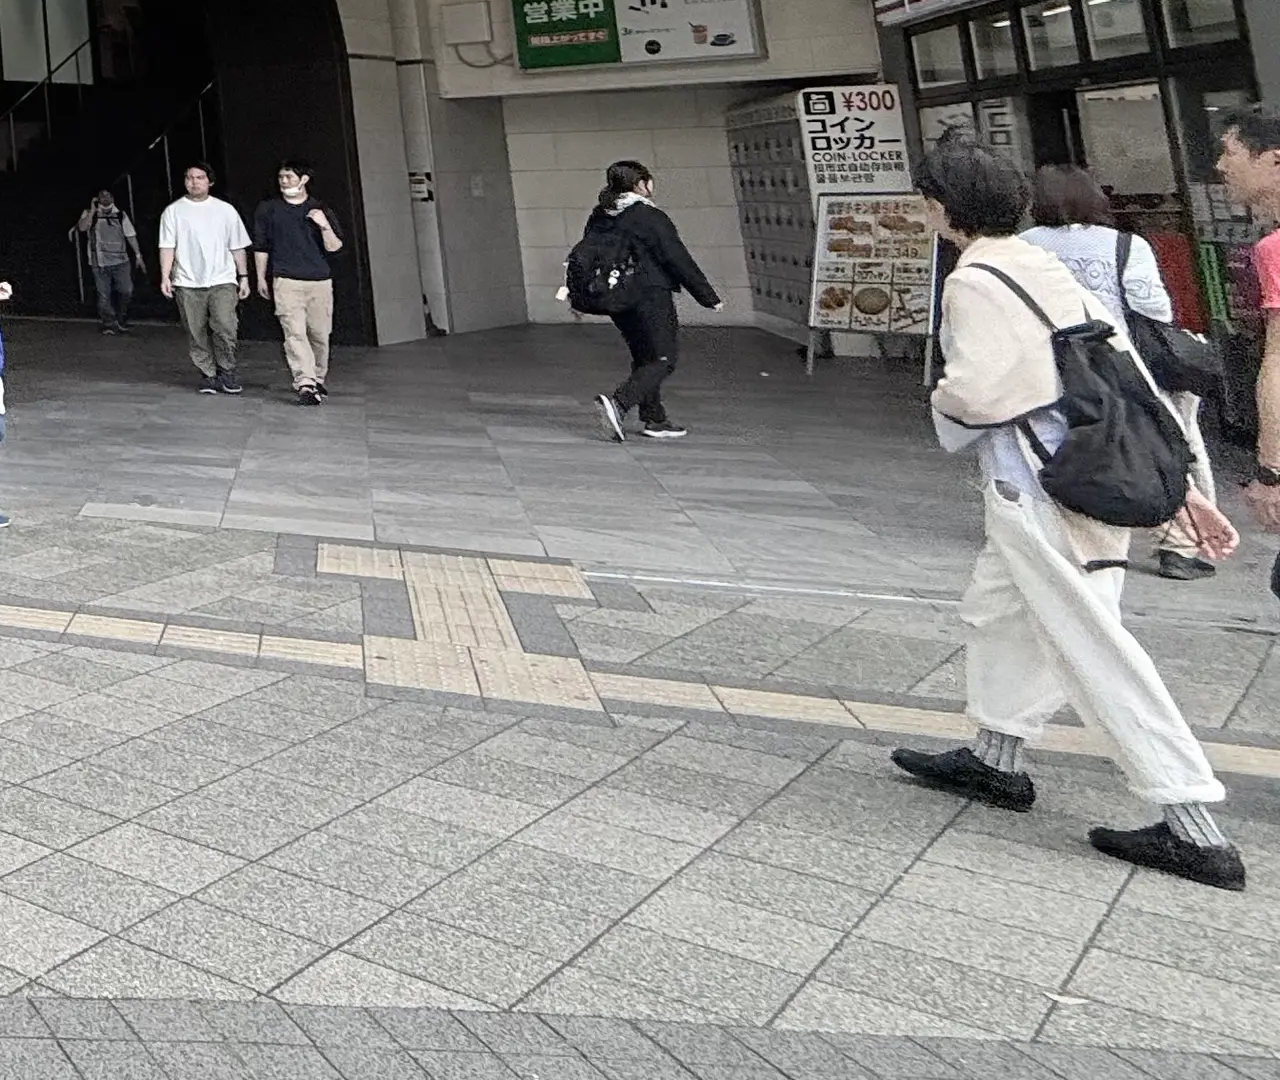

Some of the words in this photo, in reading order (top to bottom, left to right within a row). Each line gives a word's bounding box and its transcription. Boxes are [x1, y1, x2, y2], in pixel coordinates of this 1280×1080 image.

[841, 89, 895, 112] ¥300
[806, 116, 875, 133] コイン
[811, 133, 901, 151] ロッカー
[812, 150, 904, 162] COIN-LOCKER
